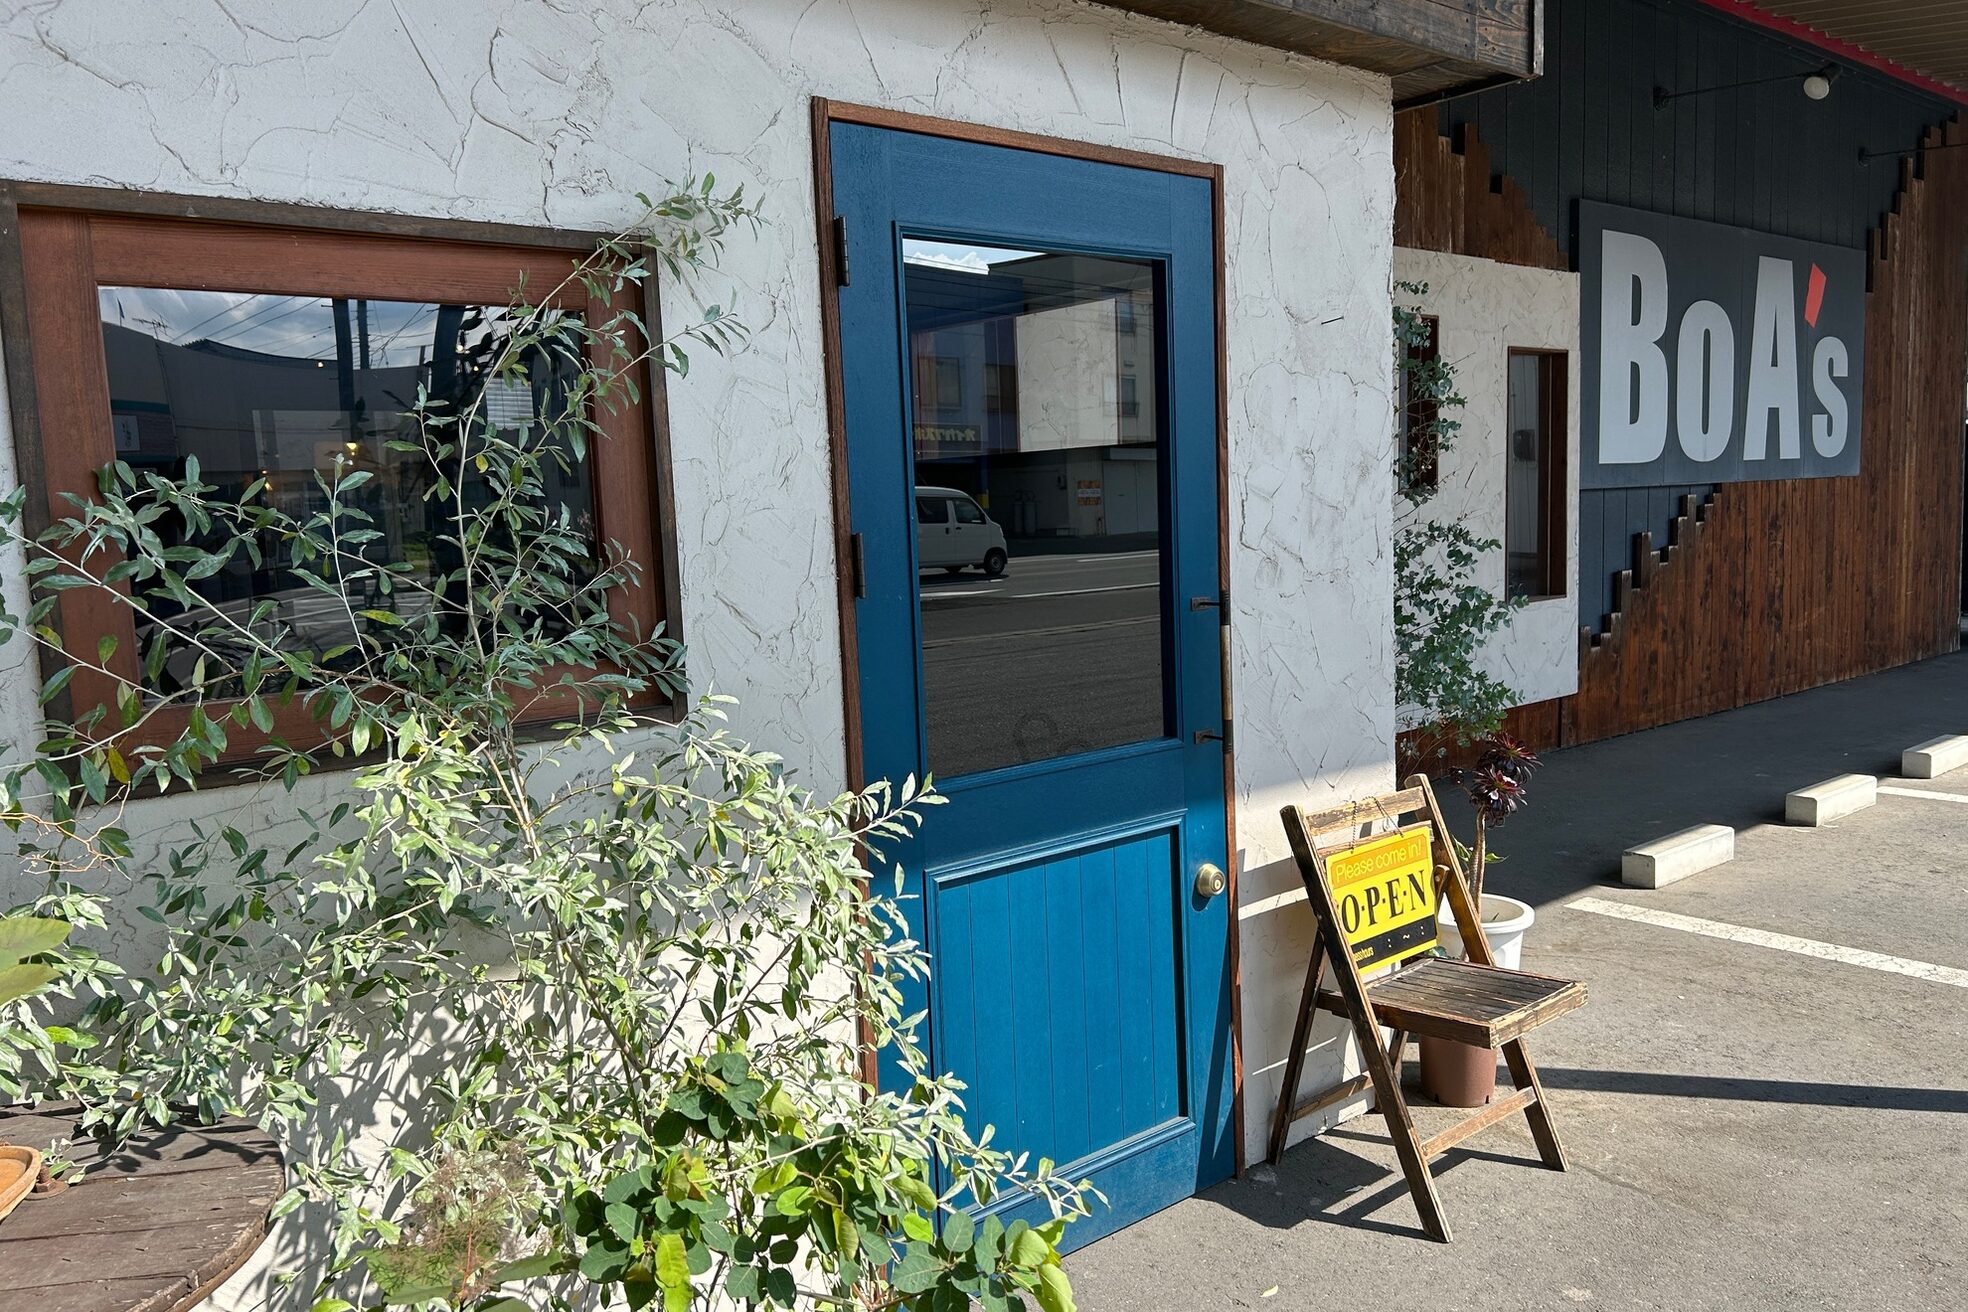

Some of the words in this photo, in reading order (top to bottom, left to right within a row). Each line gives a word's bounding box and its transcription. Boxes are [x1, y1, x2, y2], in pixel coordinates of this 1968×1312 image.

[1336, 858, 1373, 882] Please
[1376, 849, 1406, 868] come
[1408, 840, 1421, 858] in!
